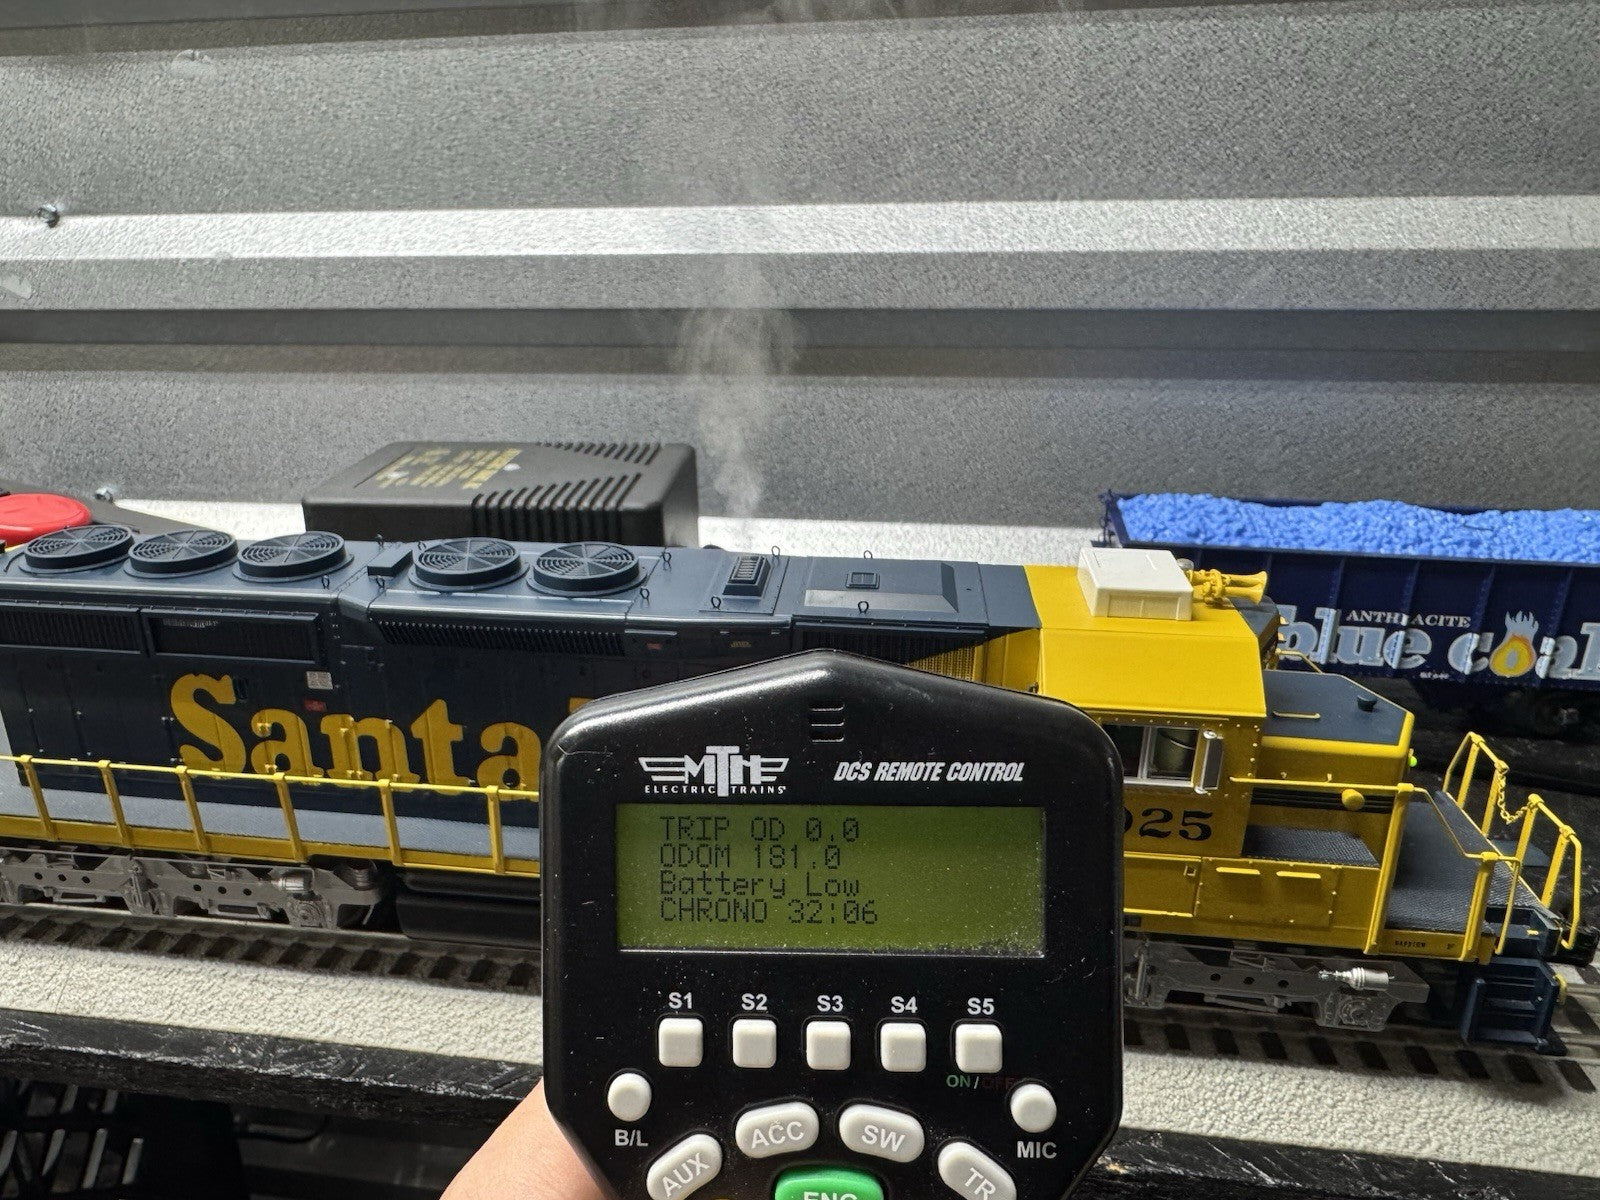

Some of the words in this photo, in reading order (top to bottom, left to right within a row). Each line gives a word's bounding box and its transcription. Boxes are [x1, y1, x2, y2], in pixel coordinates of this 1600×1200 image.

[1276, 604, 1432, 670] blue
[170, 673, 541, 801] Santa
[833, 761, 872, 782] DCS
[873, 761, 945, 782] REMOTE
[946, 762, 1025, 782] CONTROL
[645, 785, 716, 795] ELECTRIC
[731, 785, 786, 795] TRAINS
[660, 816, 730, 841] TRIP
[751, 816, 785, 842] OD
[806, 816, 859, 843] 0.0
[660, 843, 730, 868] ODOM
[754, 844, 841, 870] 181.0
[660, 870, 786, 899] Battery
[806, 872, 860, 897] Low
[660, 897, 768, 923] CHRONO
[788, 899, 878, 925] 32:06
[668, 992, 693, 1010] S1
[741, 993, 768, 1012] S2
[816, 995, 844, 1013] S3
[890, 996, 918, 1014] S4
[967, 997, 995, 1016] S5
[614, 1129, 649, 1147] B/L
[750, 1123, 806, 1150] ACC
[861, 1124, 906, 1152] SW
[1016, 1141, 1058, 1159] MIC
[662, 1152, 711, 1198] AUX
[964, 1167, 996, 1200] TR
